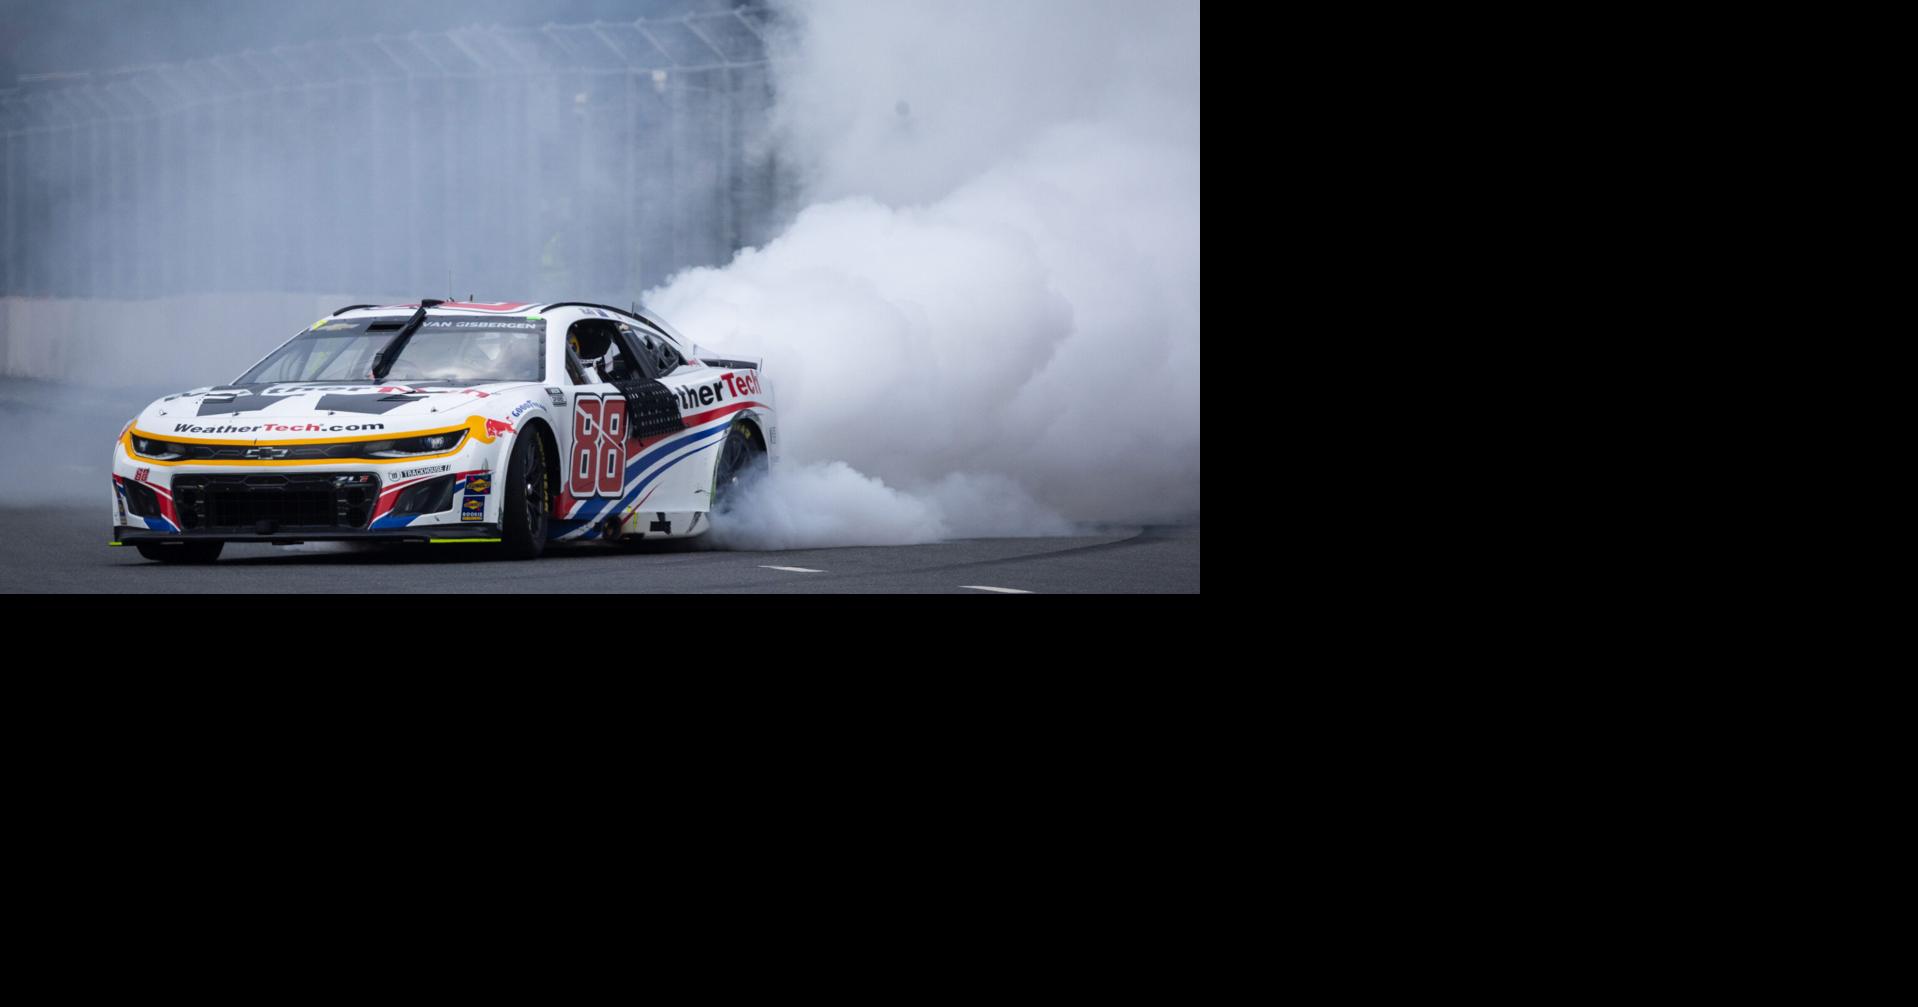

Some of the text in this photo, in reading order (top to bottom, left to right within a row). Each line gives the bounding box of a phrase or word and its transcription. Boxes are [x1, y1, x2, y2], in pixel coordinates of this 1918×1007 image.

[455, 321, 536, 329] GISBERGEN
[173, 422, 385, 434] WeatherTech.com
[569, 392, 629, 499] 88
